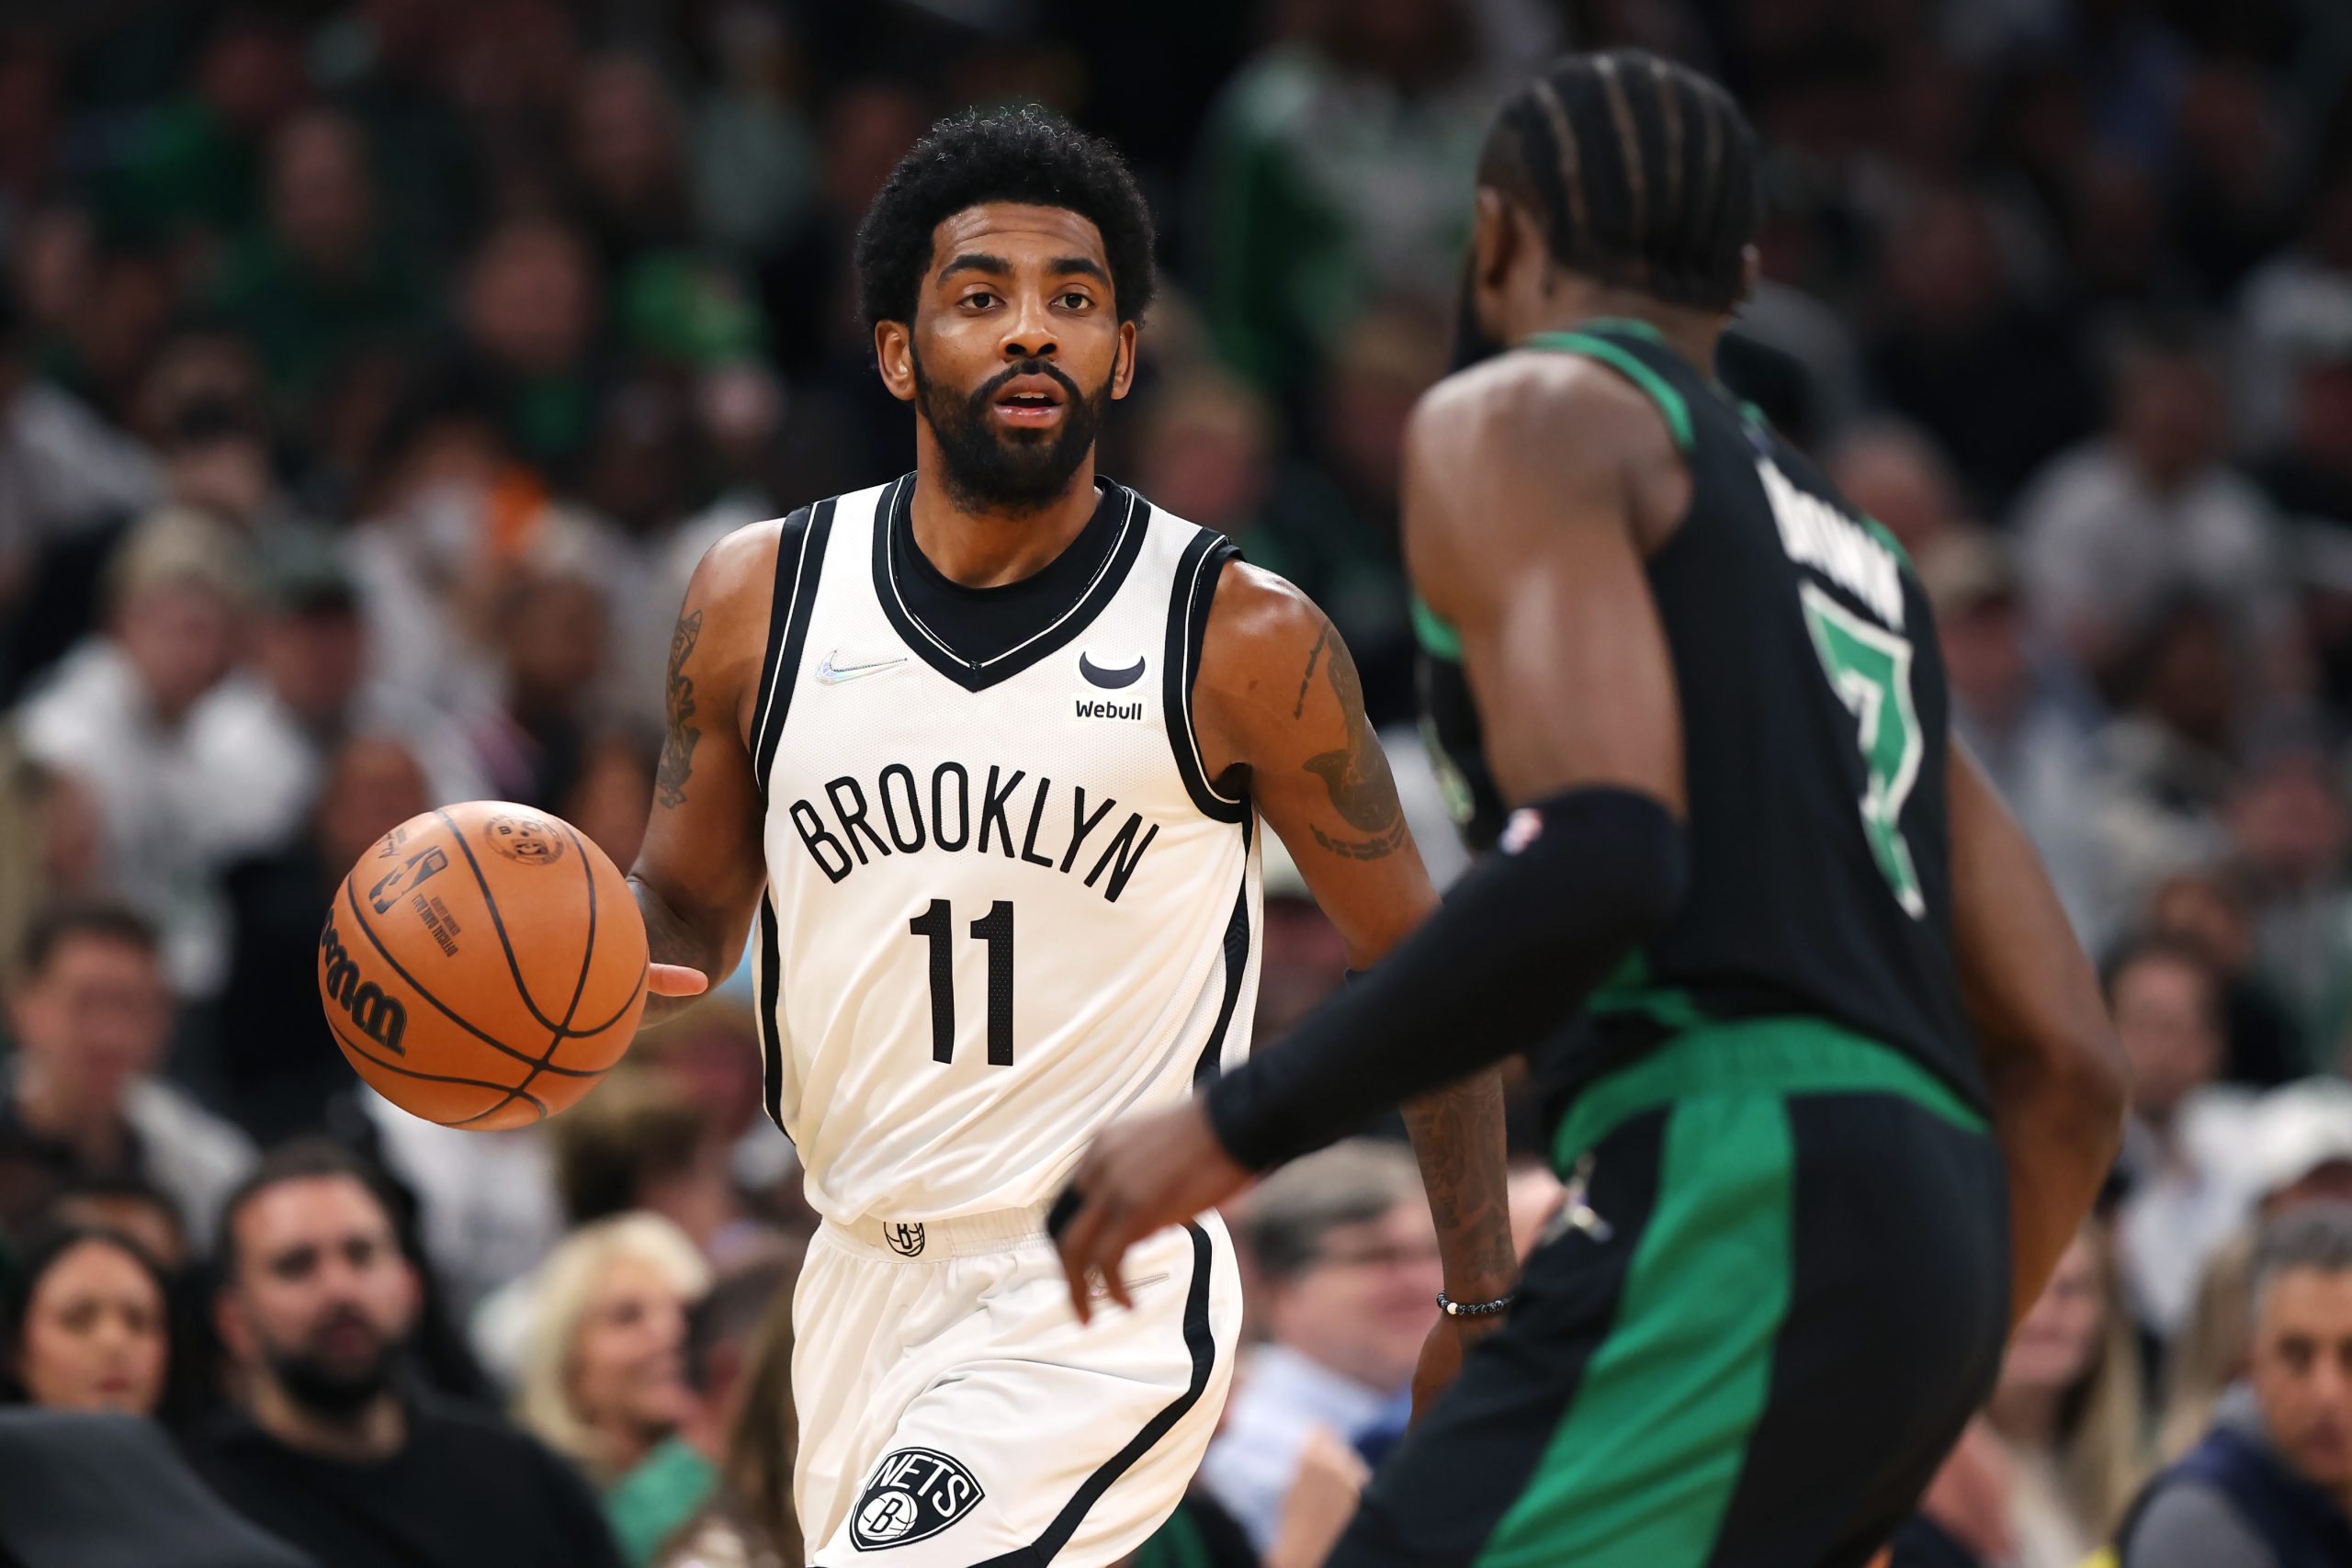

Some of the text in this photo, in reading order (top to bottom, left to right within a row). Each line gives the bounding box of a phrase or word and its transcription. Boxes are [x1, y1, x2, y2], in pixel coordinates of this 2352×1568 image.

[1076, 700, 1142, 721] Webull
[1799, 578, 1926, 920] 7
[789, 761, 1159, 903] BROOKLYN
[910, 898, 1013, 1066] 11
[866, 1453, 970, 1517] NETS
